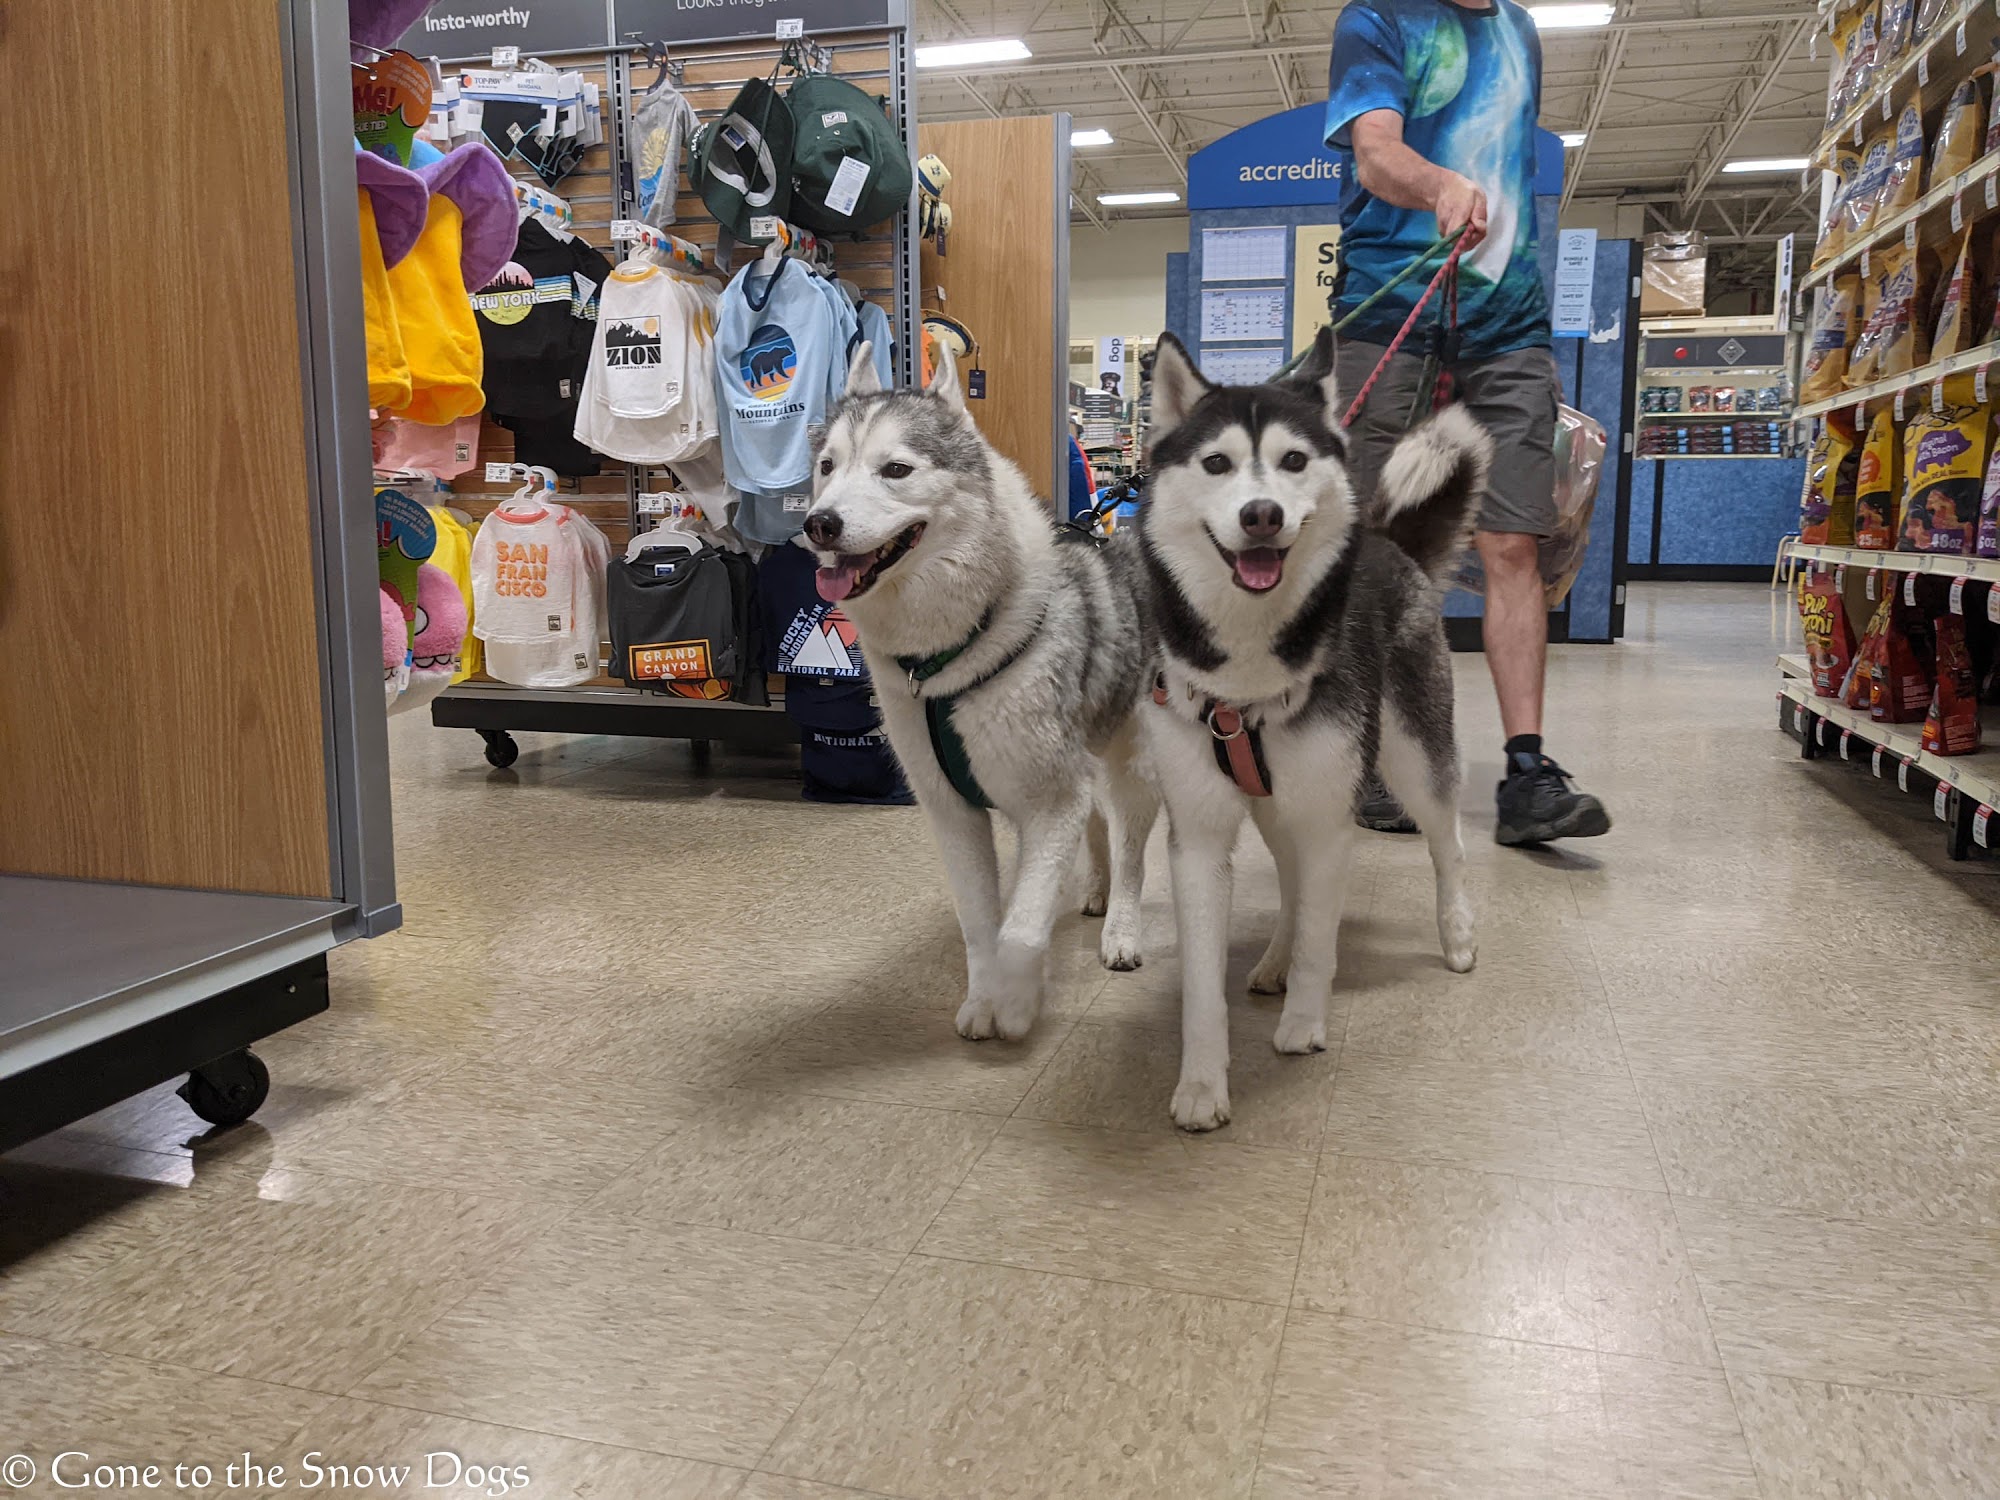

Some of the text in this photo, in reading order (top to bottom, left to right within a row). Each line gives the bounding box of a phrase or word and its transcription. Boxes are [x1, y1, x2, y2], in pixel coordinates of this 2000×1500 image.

[425, 6, 531, 32] Insta-worthy
[470, 291, 541, 310] NEW YORK
[606, 345, 661, 366] ZION
[1109, 338, 1122, 363] dog
[1931, 444, 1959, 457] Bacon
[495, 541, 548, 564] SAN
[496, 563, 547, 581] FRAN
[495, 579, 547, 598] CISCO
[779, 607, 808, 653] ROCKY
[788, 603, 824, 659] MOUNTAIN
[643, 647, 697, 663] GRAND
[644, 660, 698, 674] CANYON
[777, 664, 860, 677] NATIONAL PARK
